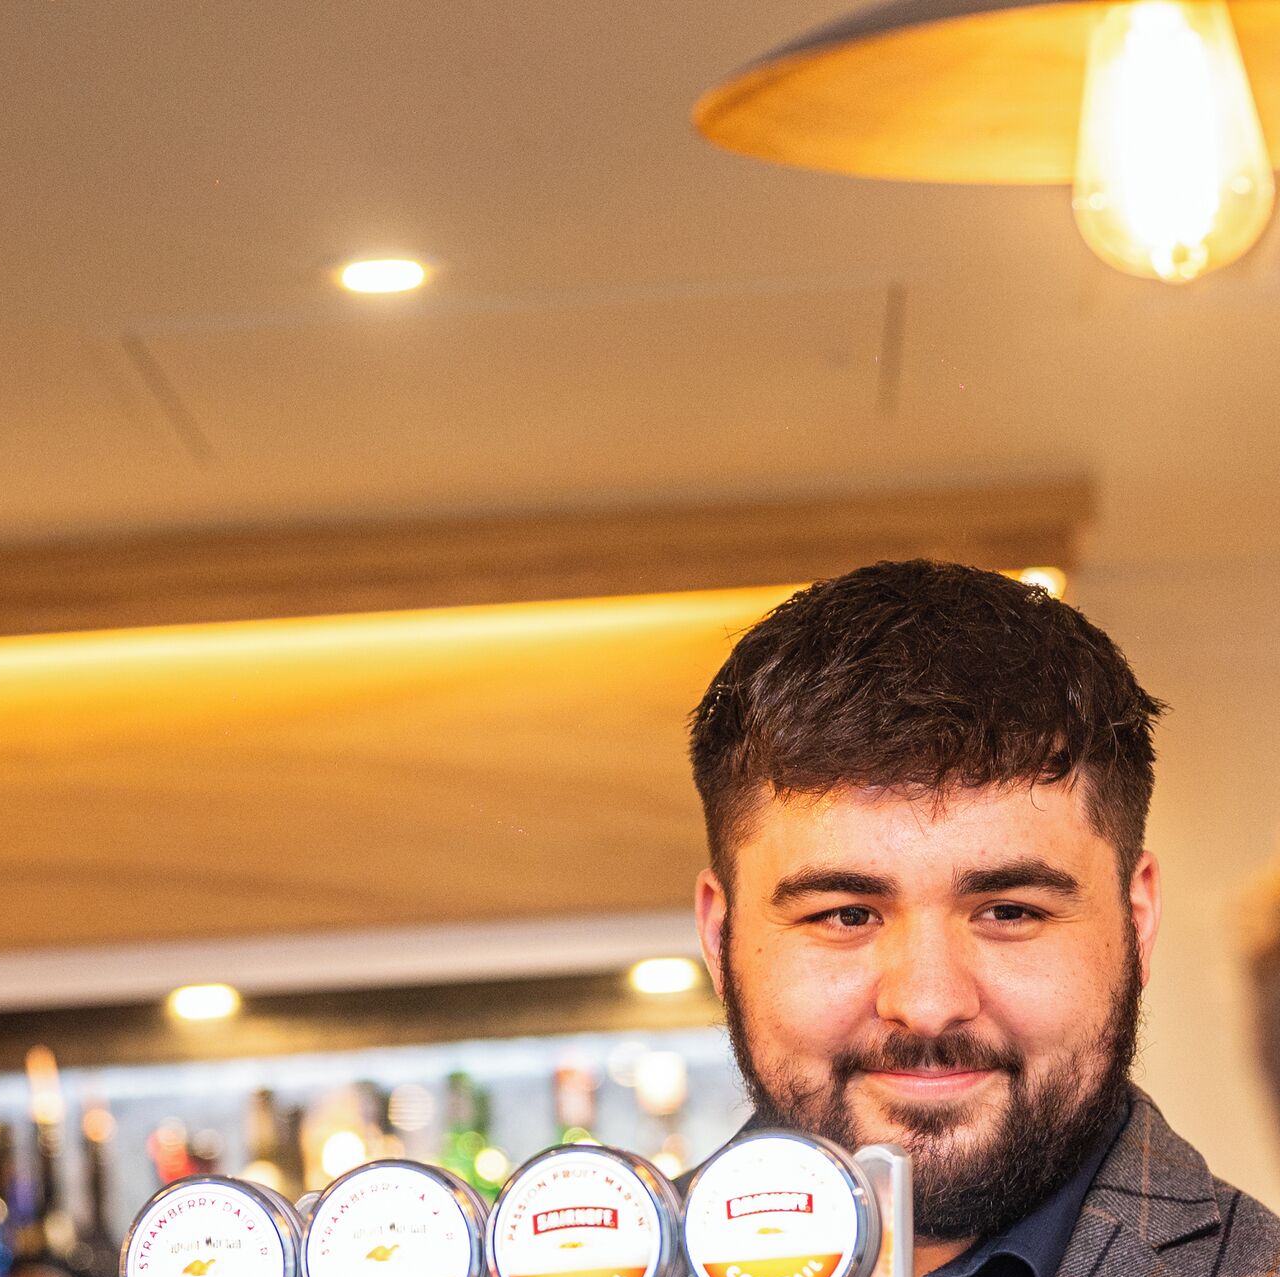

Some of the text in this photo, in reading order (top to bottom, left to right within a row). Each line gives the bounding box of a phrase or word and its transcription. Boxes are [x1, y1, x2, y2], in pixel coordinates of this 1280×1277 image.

[139, 1198, 269, 1270] STRAWBERRY DAIQR
[507, 1180, 547, 1240] PASSON
